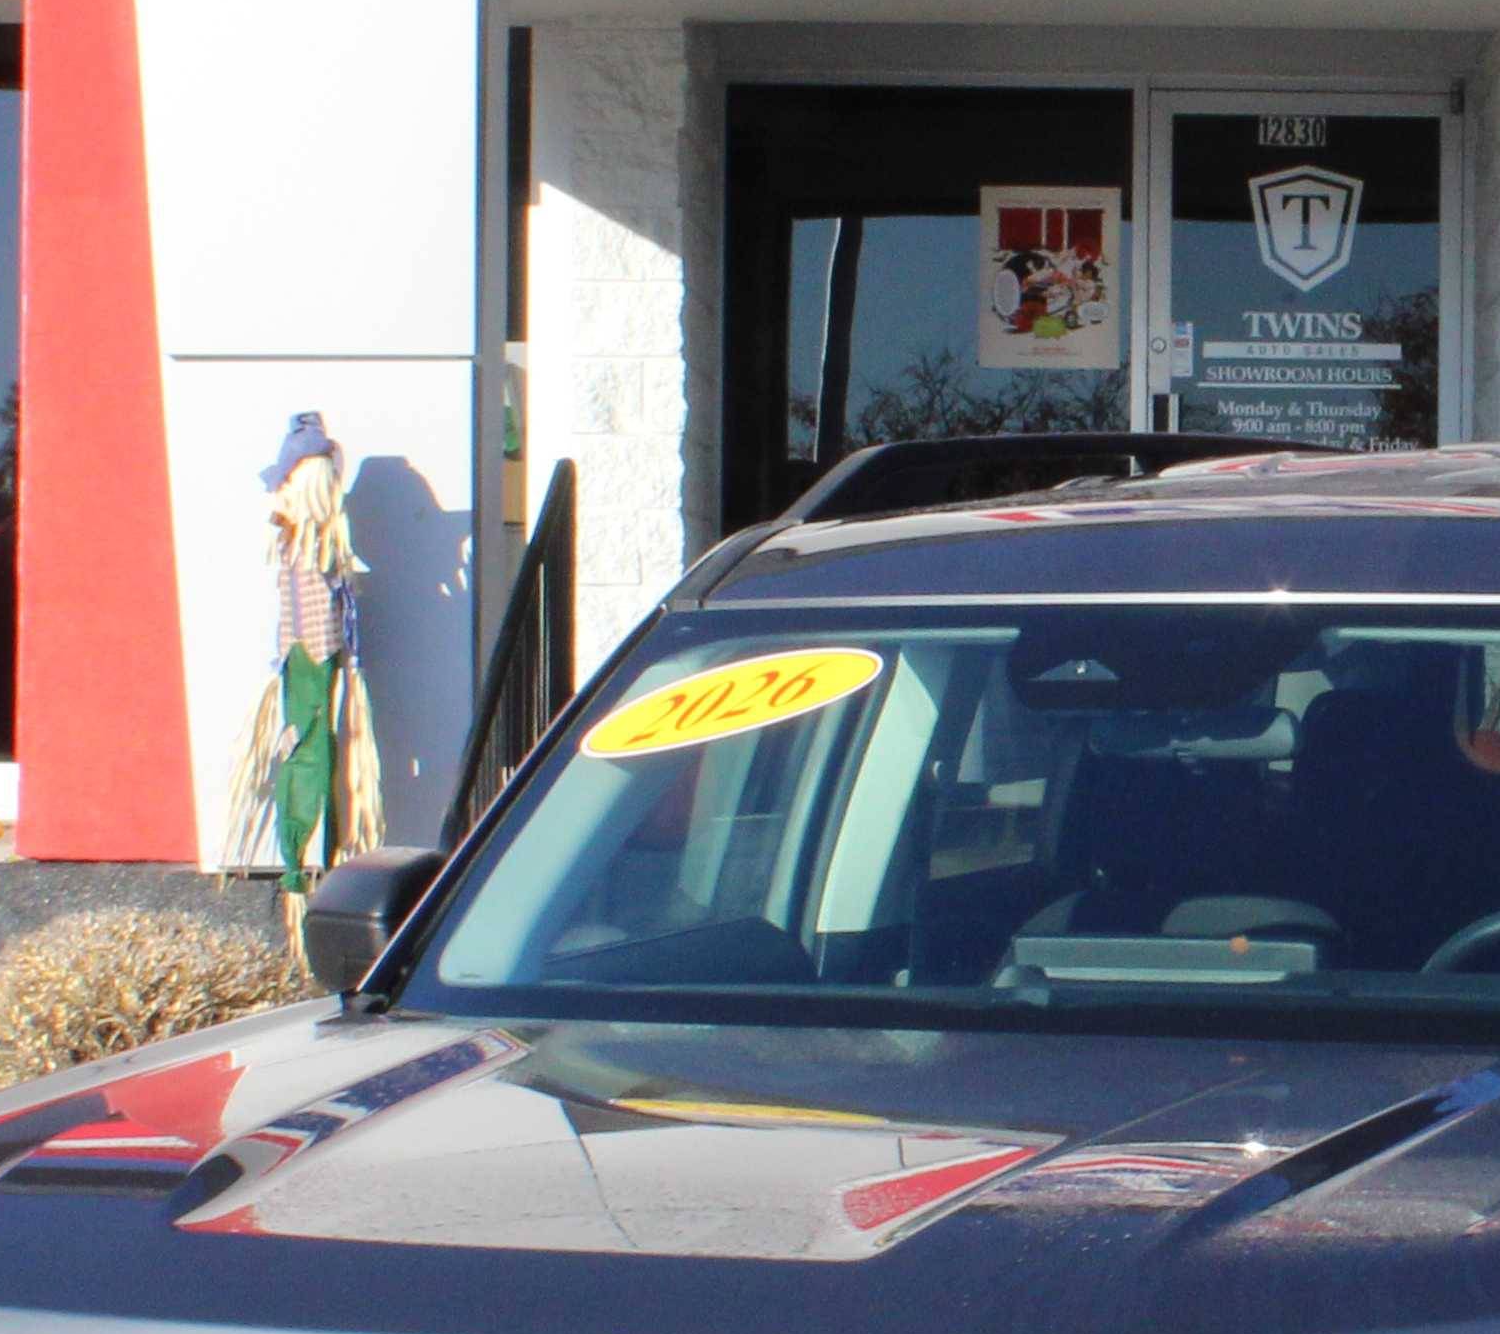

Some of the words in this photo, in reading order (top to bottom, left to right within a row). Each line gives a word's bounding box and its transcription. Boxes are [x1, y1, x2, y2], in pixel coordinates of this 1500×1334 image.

[1260, 116, 1326, 145] 12830
[1282, 194, 1330, 250] T
[1243, 311, 1363, 340] TWINS
[1246, 344, 1292, 355] AUTO
[1205, 366, 1322, 382] SHOWROOM
[1327, 368, 1392, 382] HOURS
[1217, 400, 1283, 417] Monday
[1287, 401, 1301, 416] &
[1306, 401, 1381, 419] Thursday
[1232, 419, 1263, 433] 9:00
[1267, 422, 1291, 433] am
[1339, 422, 1366, 436] pm
[1369, 436, 1420, 453] Friday
[623, 659, 838, 747] 2026
